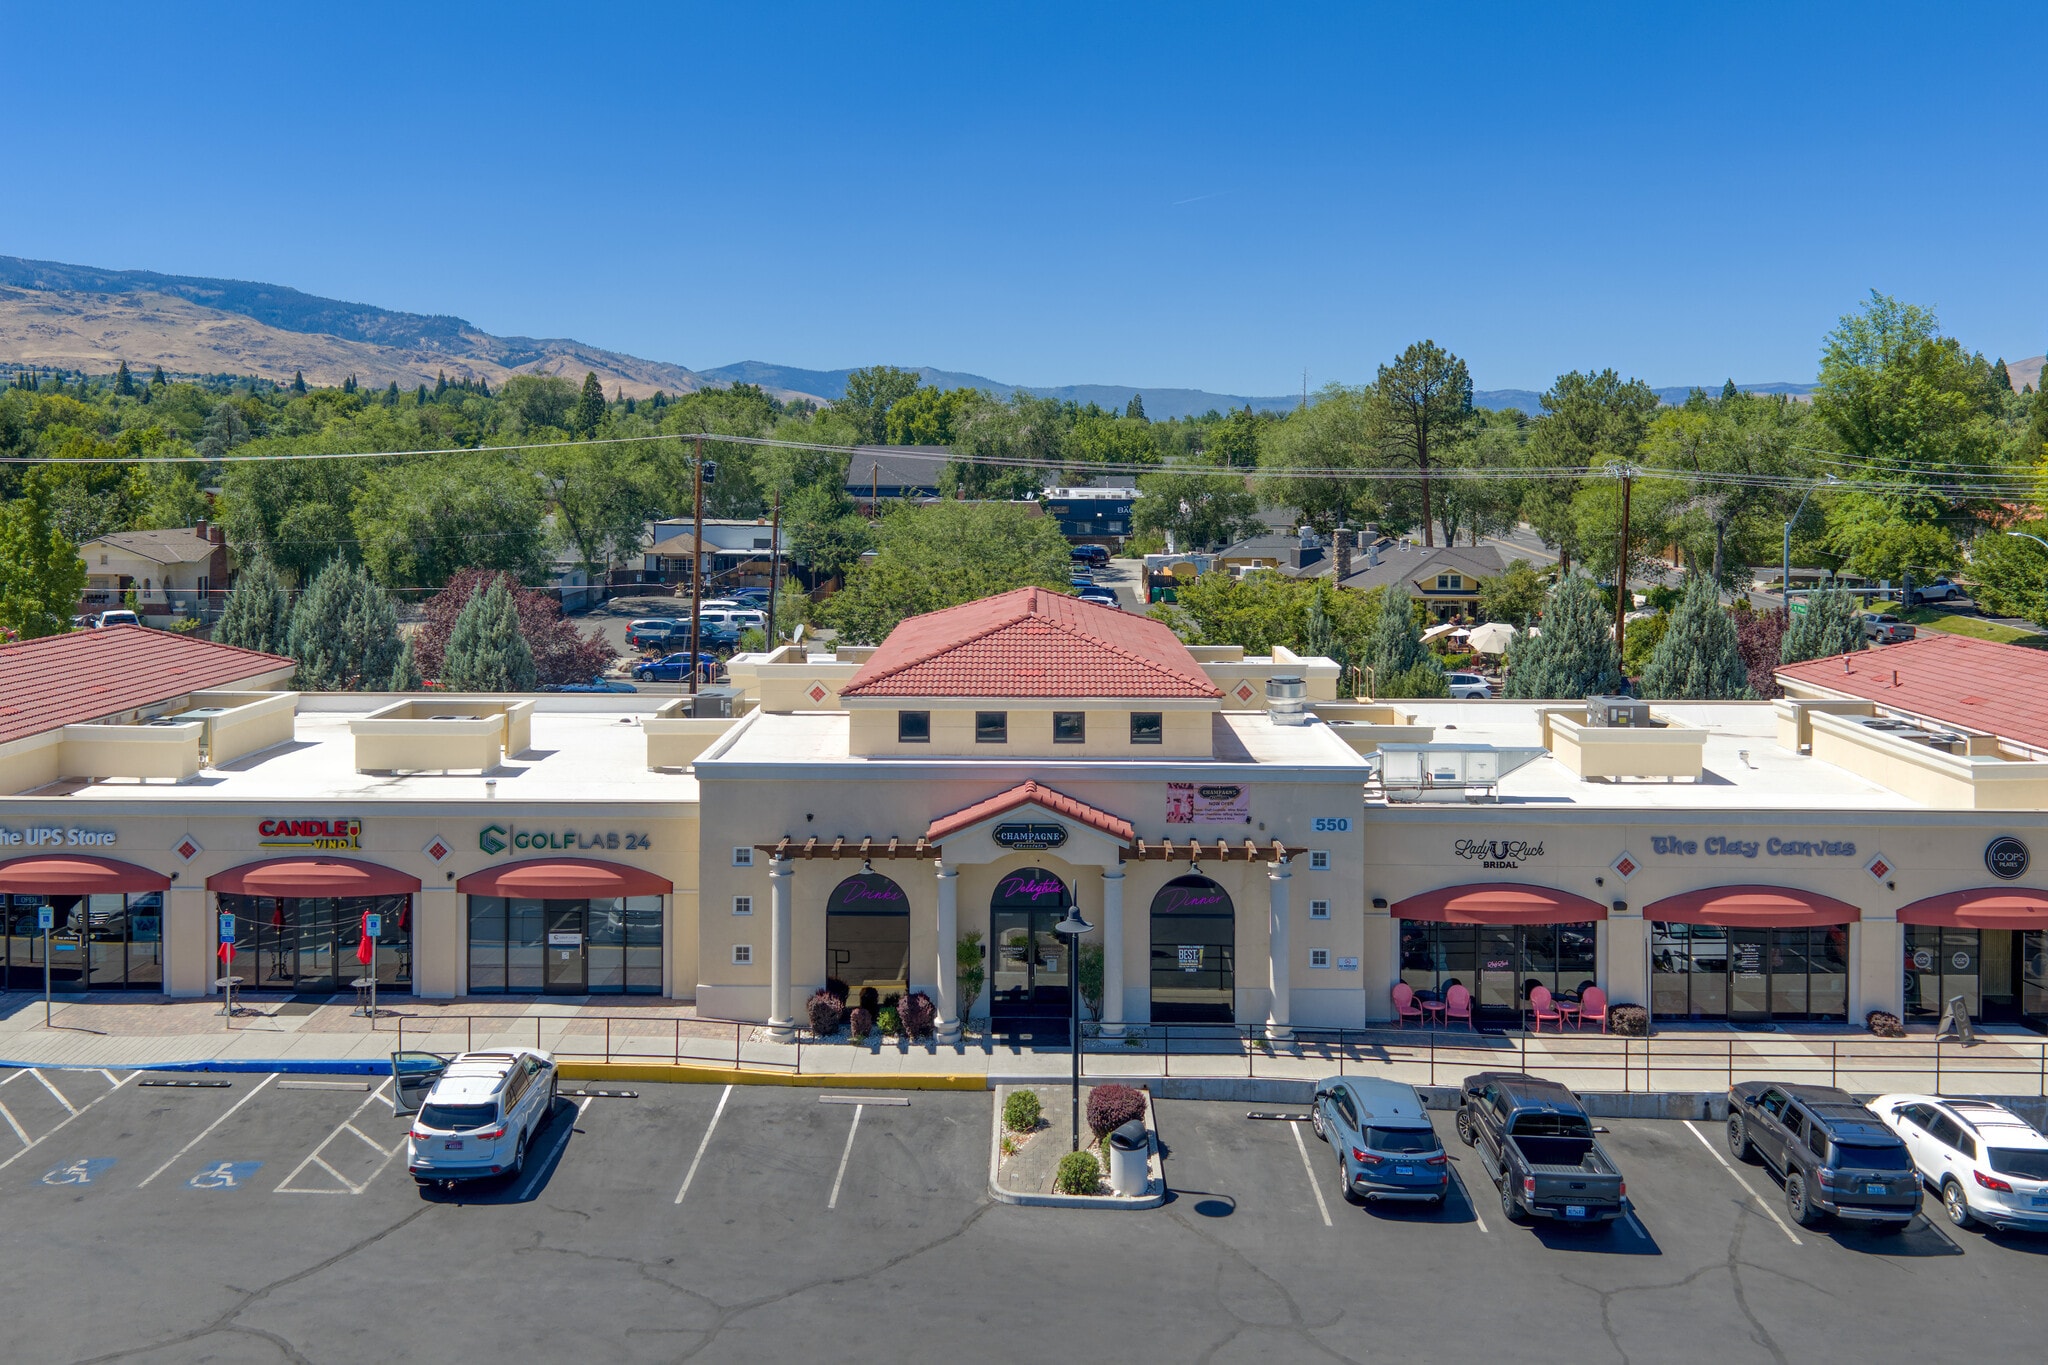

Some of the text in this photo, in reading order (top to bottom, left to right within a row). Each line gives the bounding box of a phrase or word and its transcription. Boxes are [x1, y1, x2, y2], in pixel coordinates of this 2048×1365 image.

[258, 820, 348, 837] CANDLE
[1316, 818, 1348, 831] 550
[0, 828, 116, 846] he UPS Store
[313, 839, 349, 849] VINO
[625, 832, 651, 850] 24
[1001, 832, 1060, 841] CHAMPAGNE
[1454, 839, 1545, 861] Lady Luck
[1651, 836, 1857, 859] The Clay Canvas
[1483, 861, 1519, 869] BRIDAL
[1993, 852, 2024, 862] LOOPS
[838, 880, 903, 904] Drinks
[1000, 877, 1064, 900] Delights
[1158, 887, 1224, 913] Dinner
